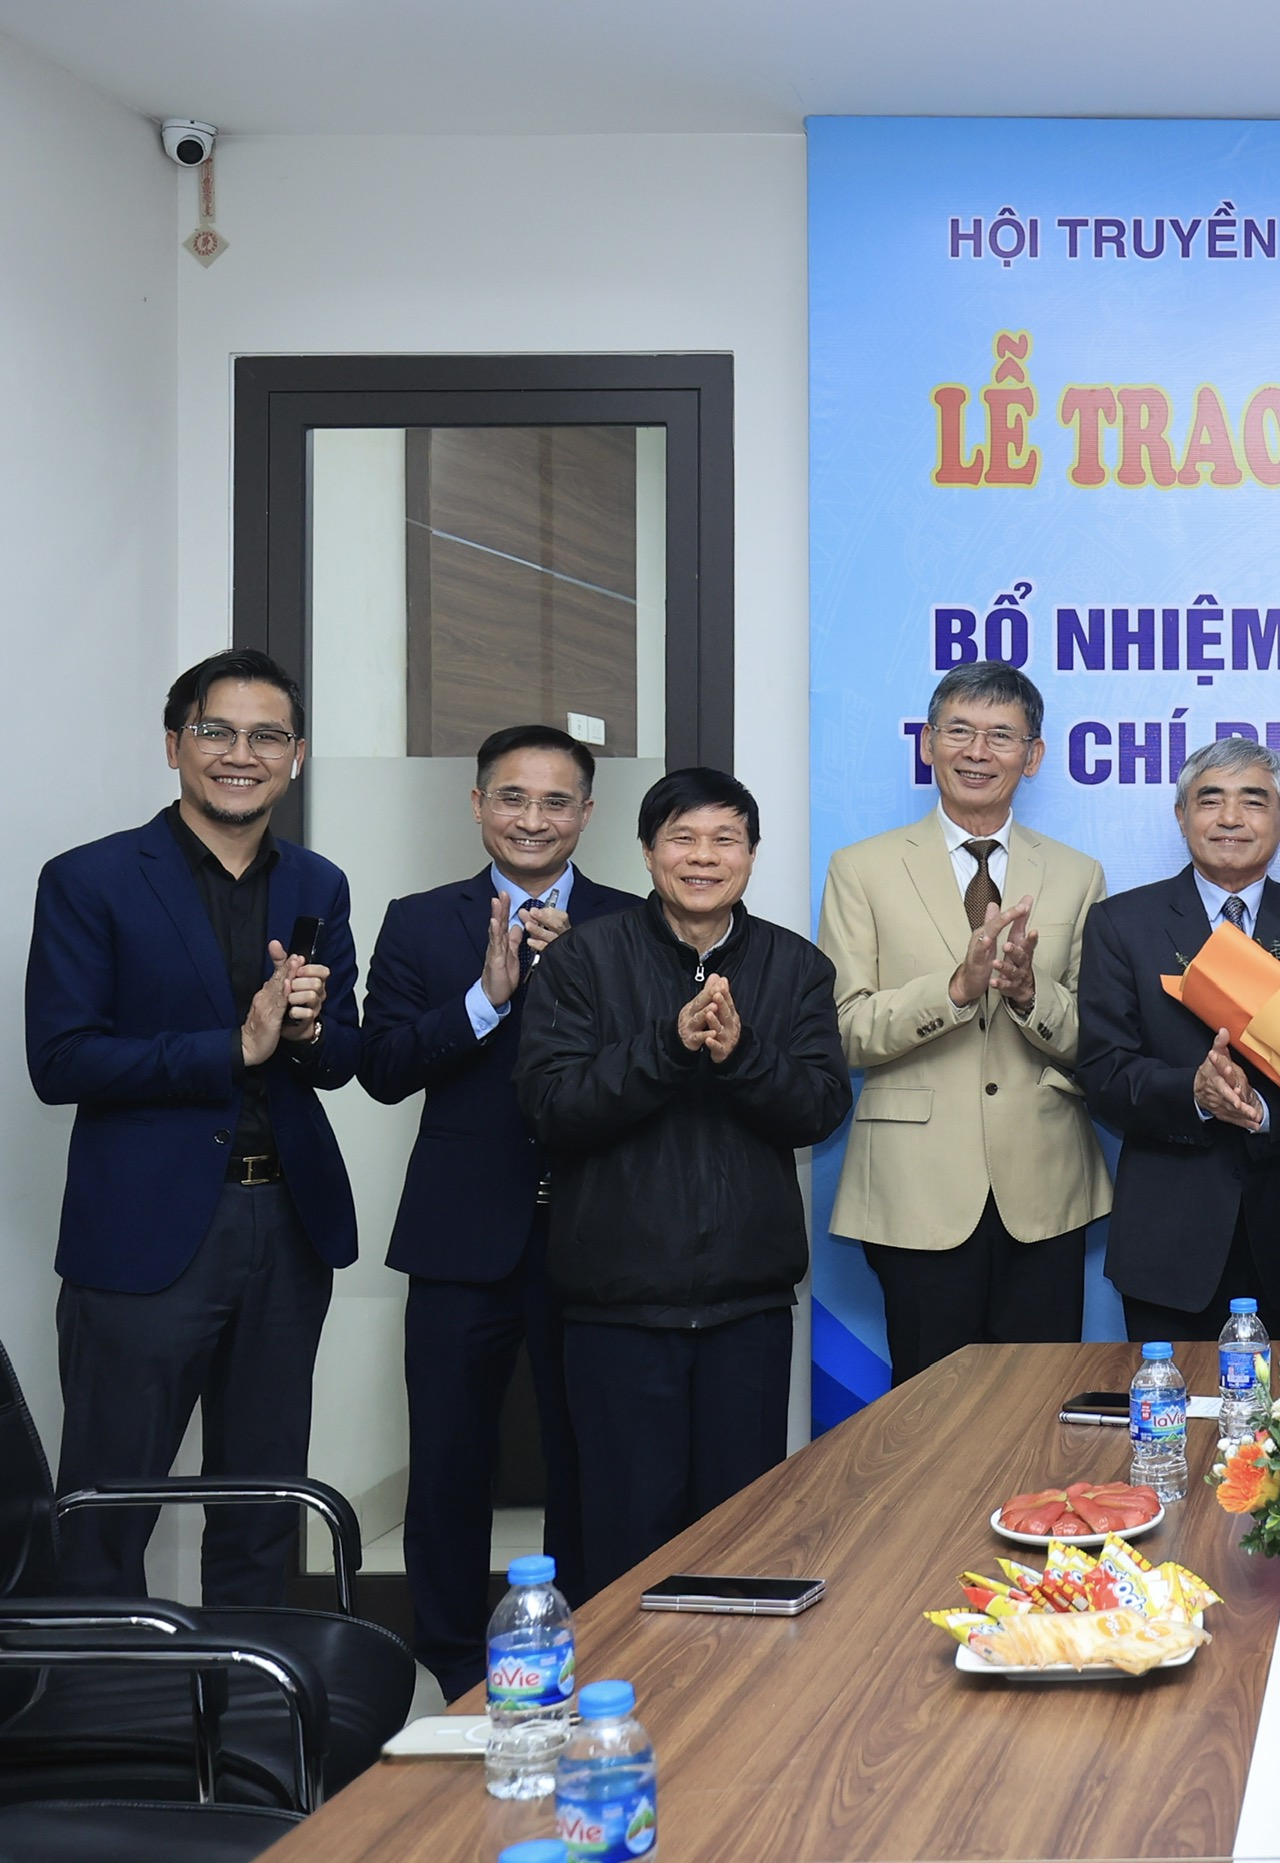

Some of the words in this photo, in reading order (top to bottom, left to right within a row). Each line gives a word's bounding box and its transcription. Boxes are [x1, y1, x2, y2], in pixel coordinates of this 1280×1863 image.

[950, 207, 1038, 267] HỘI
[1058, 201, 1276, 259] TRUYỀN
[932, 332, 1039, 487] LỄ
[935, 582, 1032, 669] BỔ
[1068, 708, 1188, 784] CHÍ
[1153, 1411, 1185, 1427] laVie
